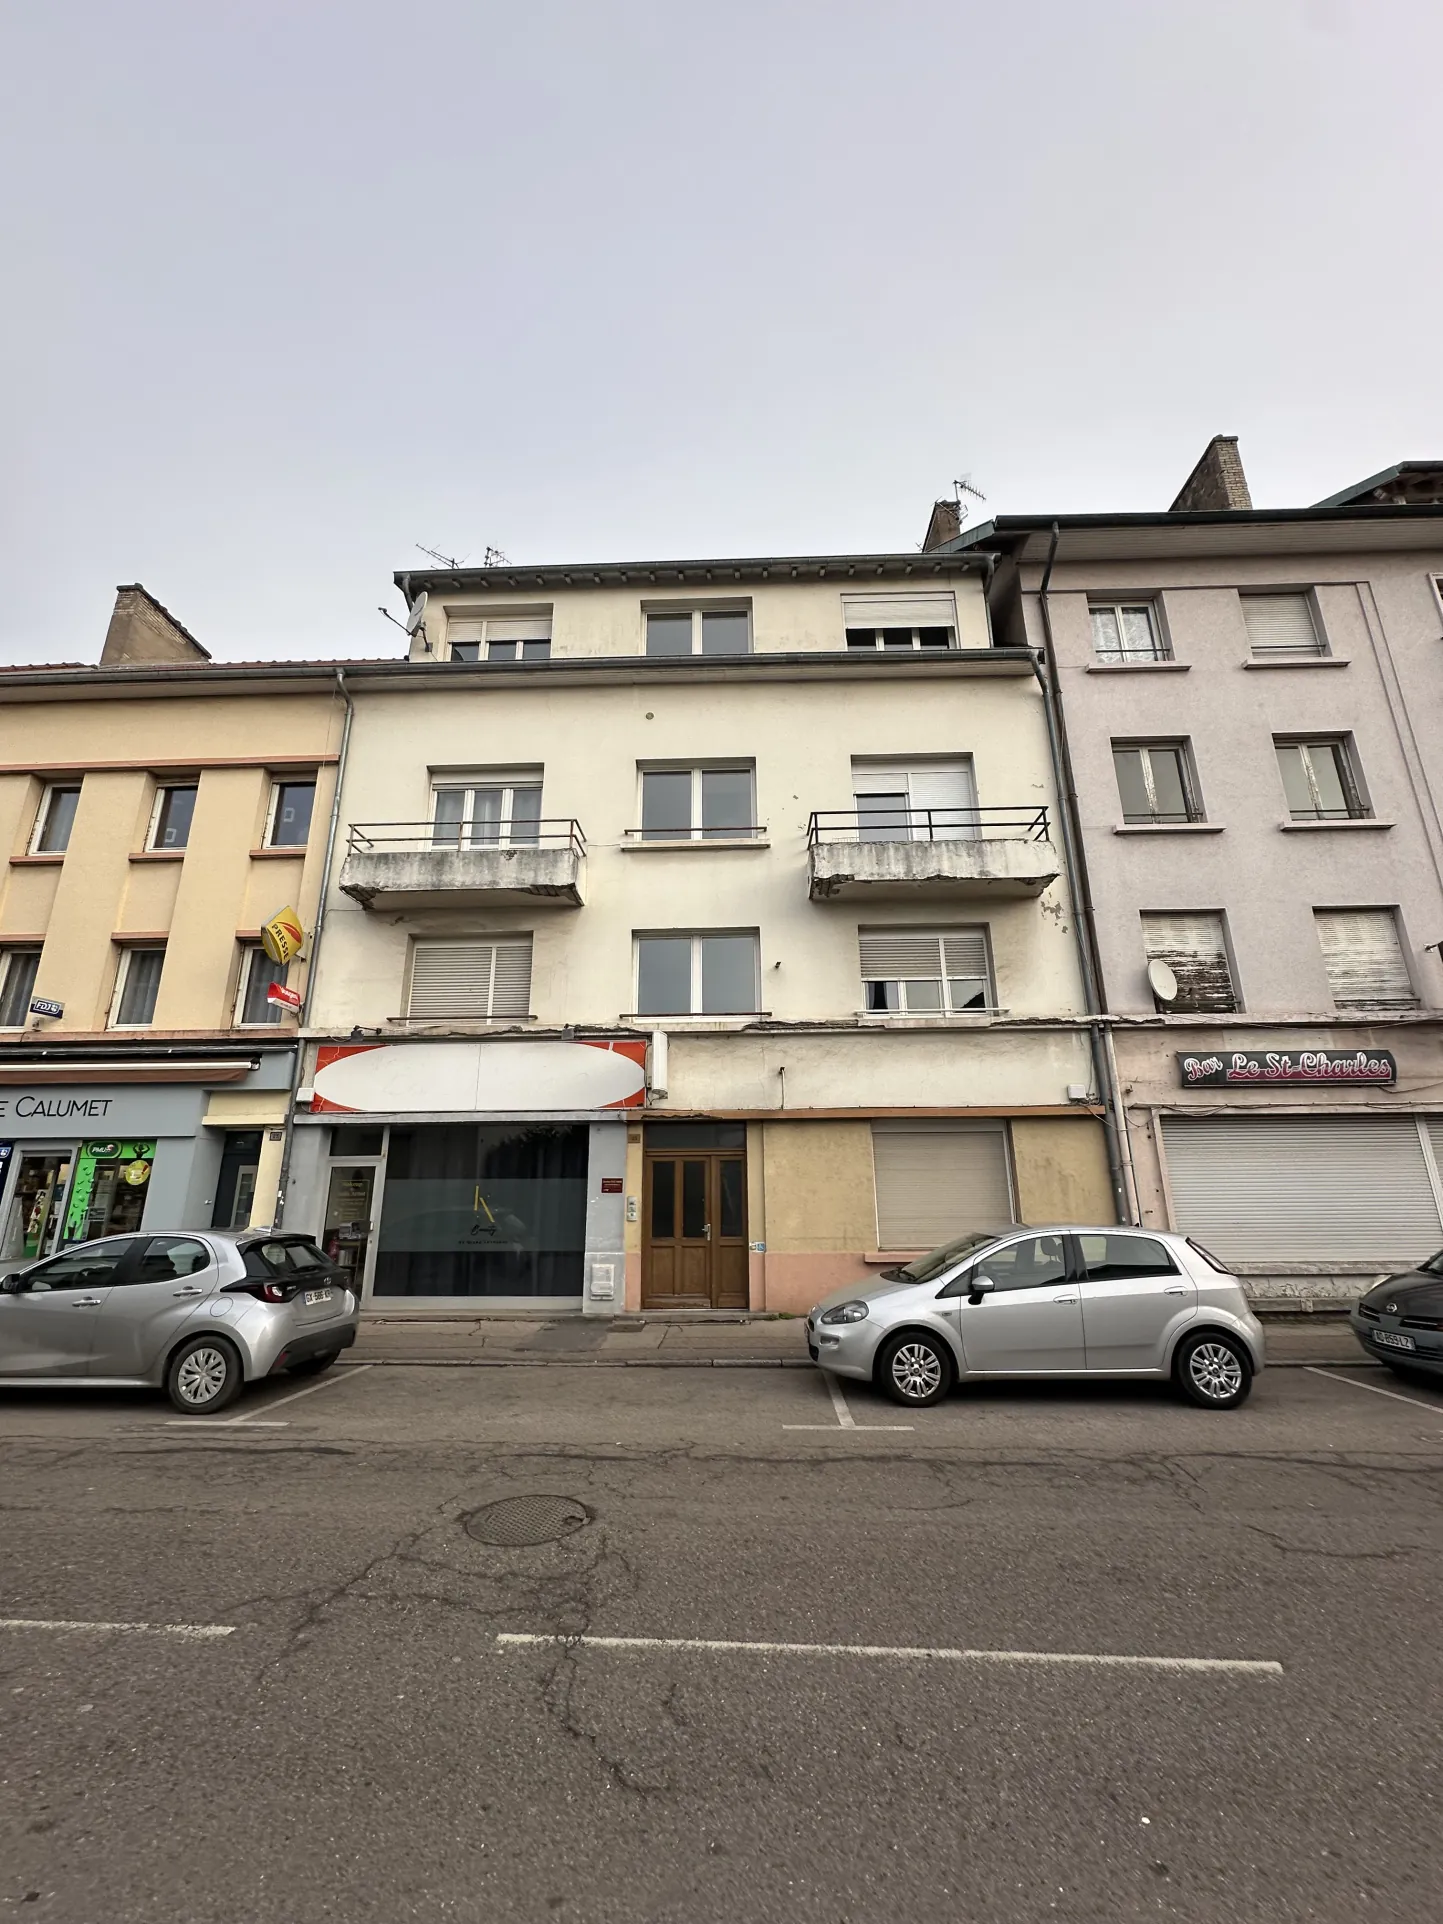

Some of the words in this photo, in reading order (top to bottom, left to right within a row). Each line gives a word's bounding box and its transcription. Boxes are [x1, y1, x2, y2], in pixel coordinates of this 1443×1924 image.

[271, 923, 289, 960] PRESSE
[36, 1002, 51, 1011] FDJ
[1184, 1056, 1223, 1081] Bar
[1228, 1053, 1260, 1078] Le
[0, 1101, 9, 1117] E
[15, 1096, 113, 1118] CALUMET
